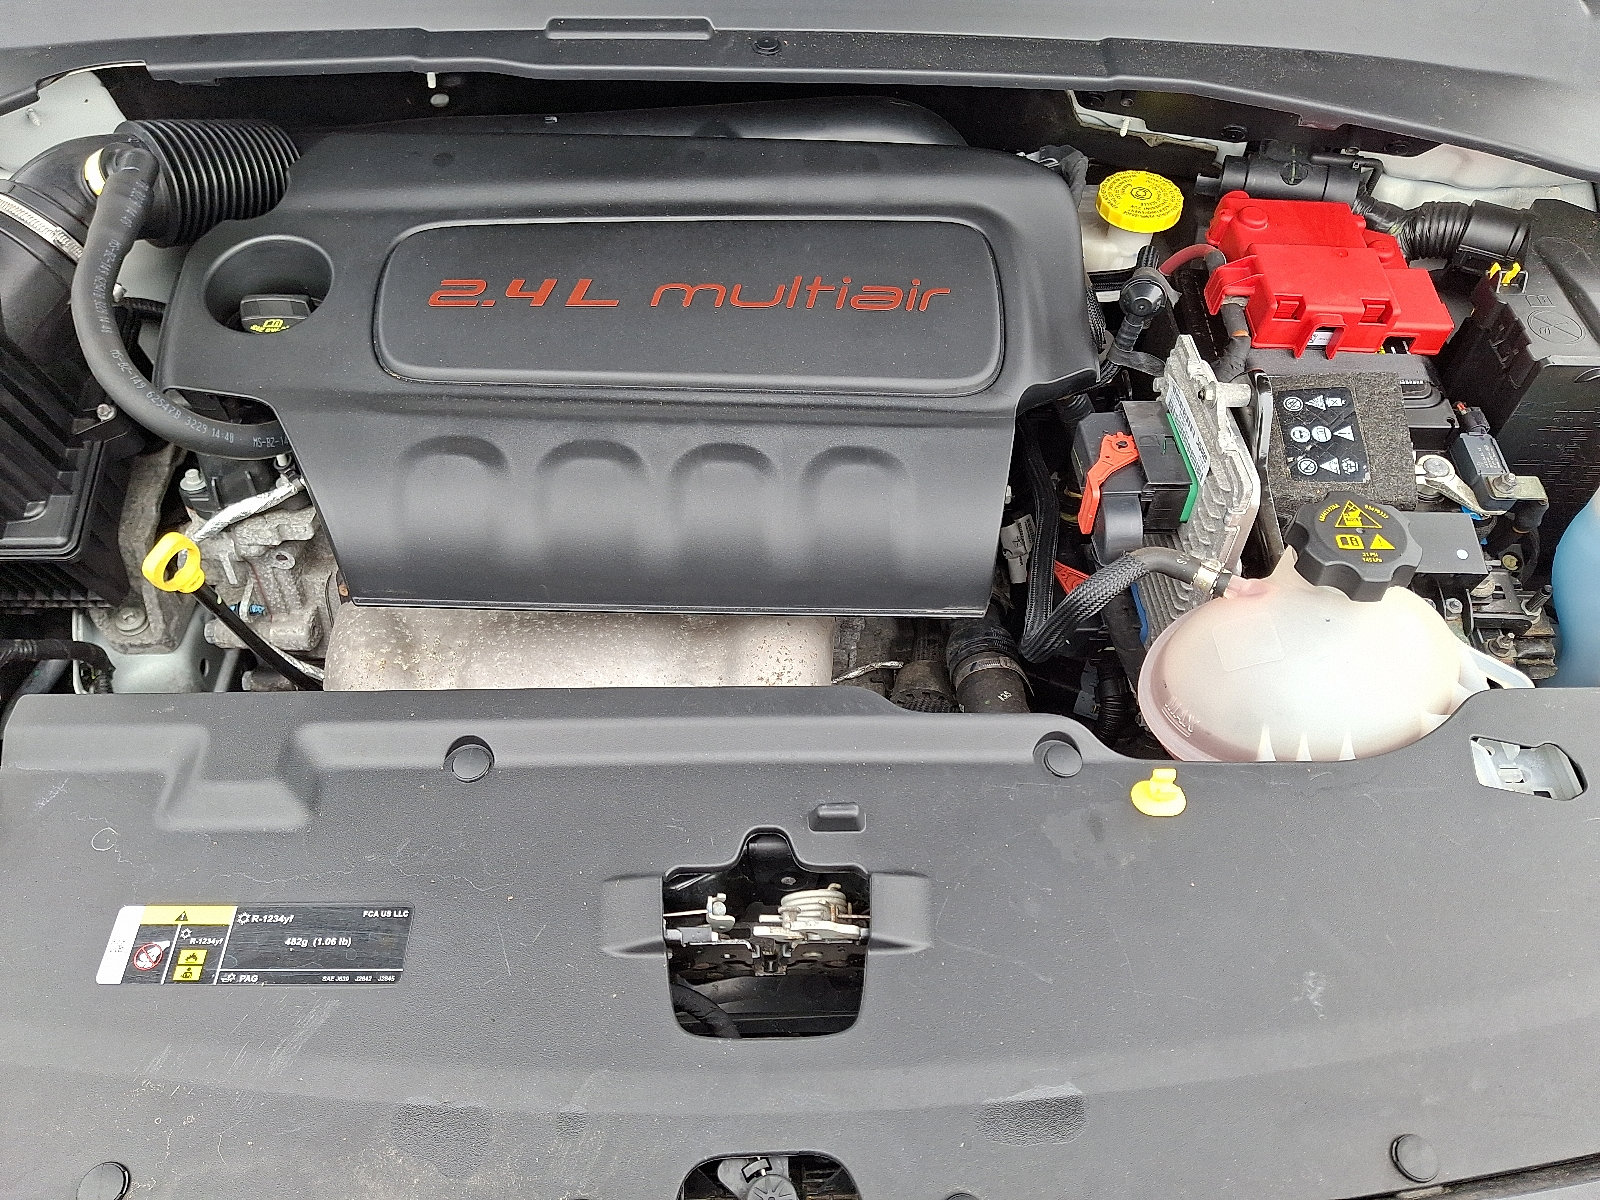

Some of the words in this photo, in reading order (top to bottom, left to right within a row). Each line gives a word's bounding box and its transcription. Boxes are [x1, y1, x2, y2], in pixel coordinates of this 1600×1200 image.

[649, 275, 951, 312] multiair
[362, 910, 379, 918] FCA
[380, 910, 391, 918] US
[393, 910, 409, 918] LLC
[250, 914, 294, 925] R-1234yf
[239, 974, 258, 983] PAG
